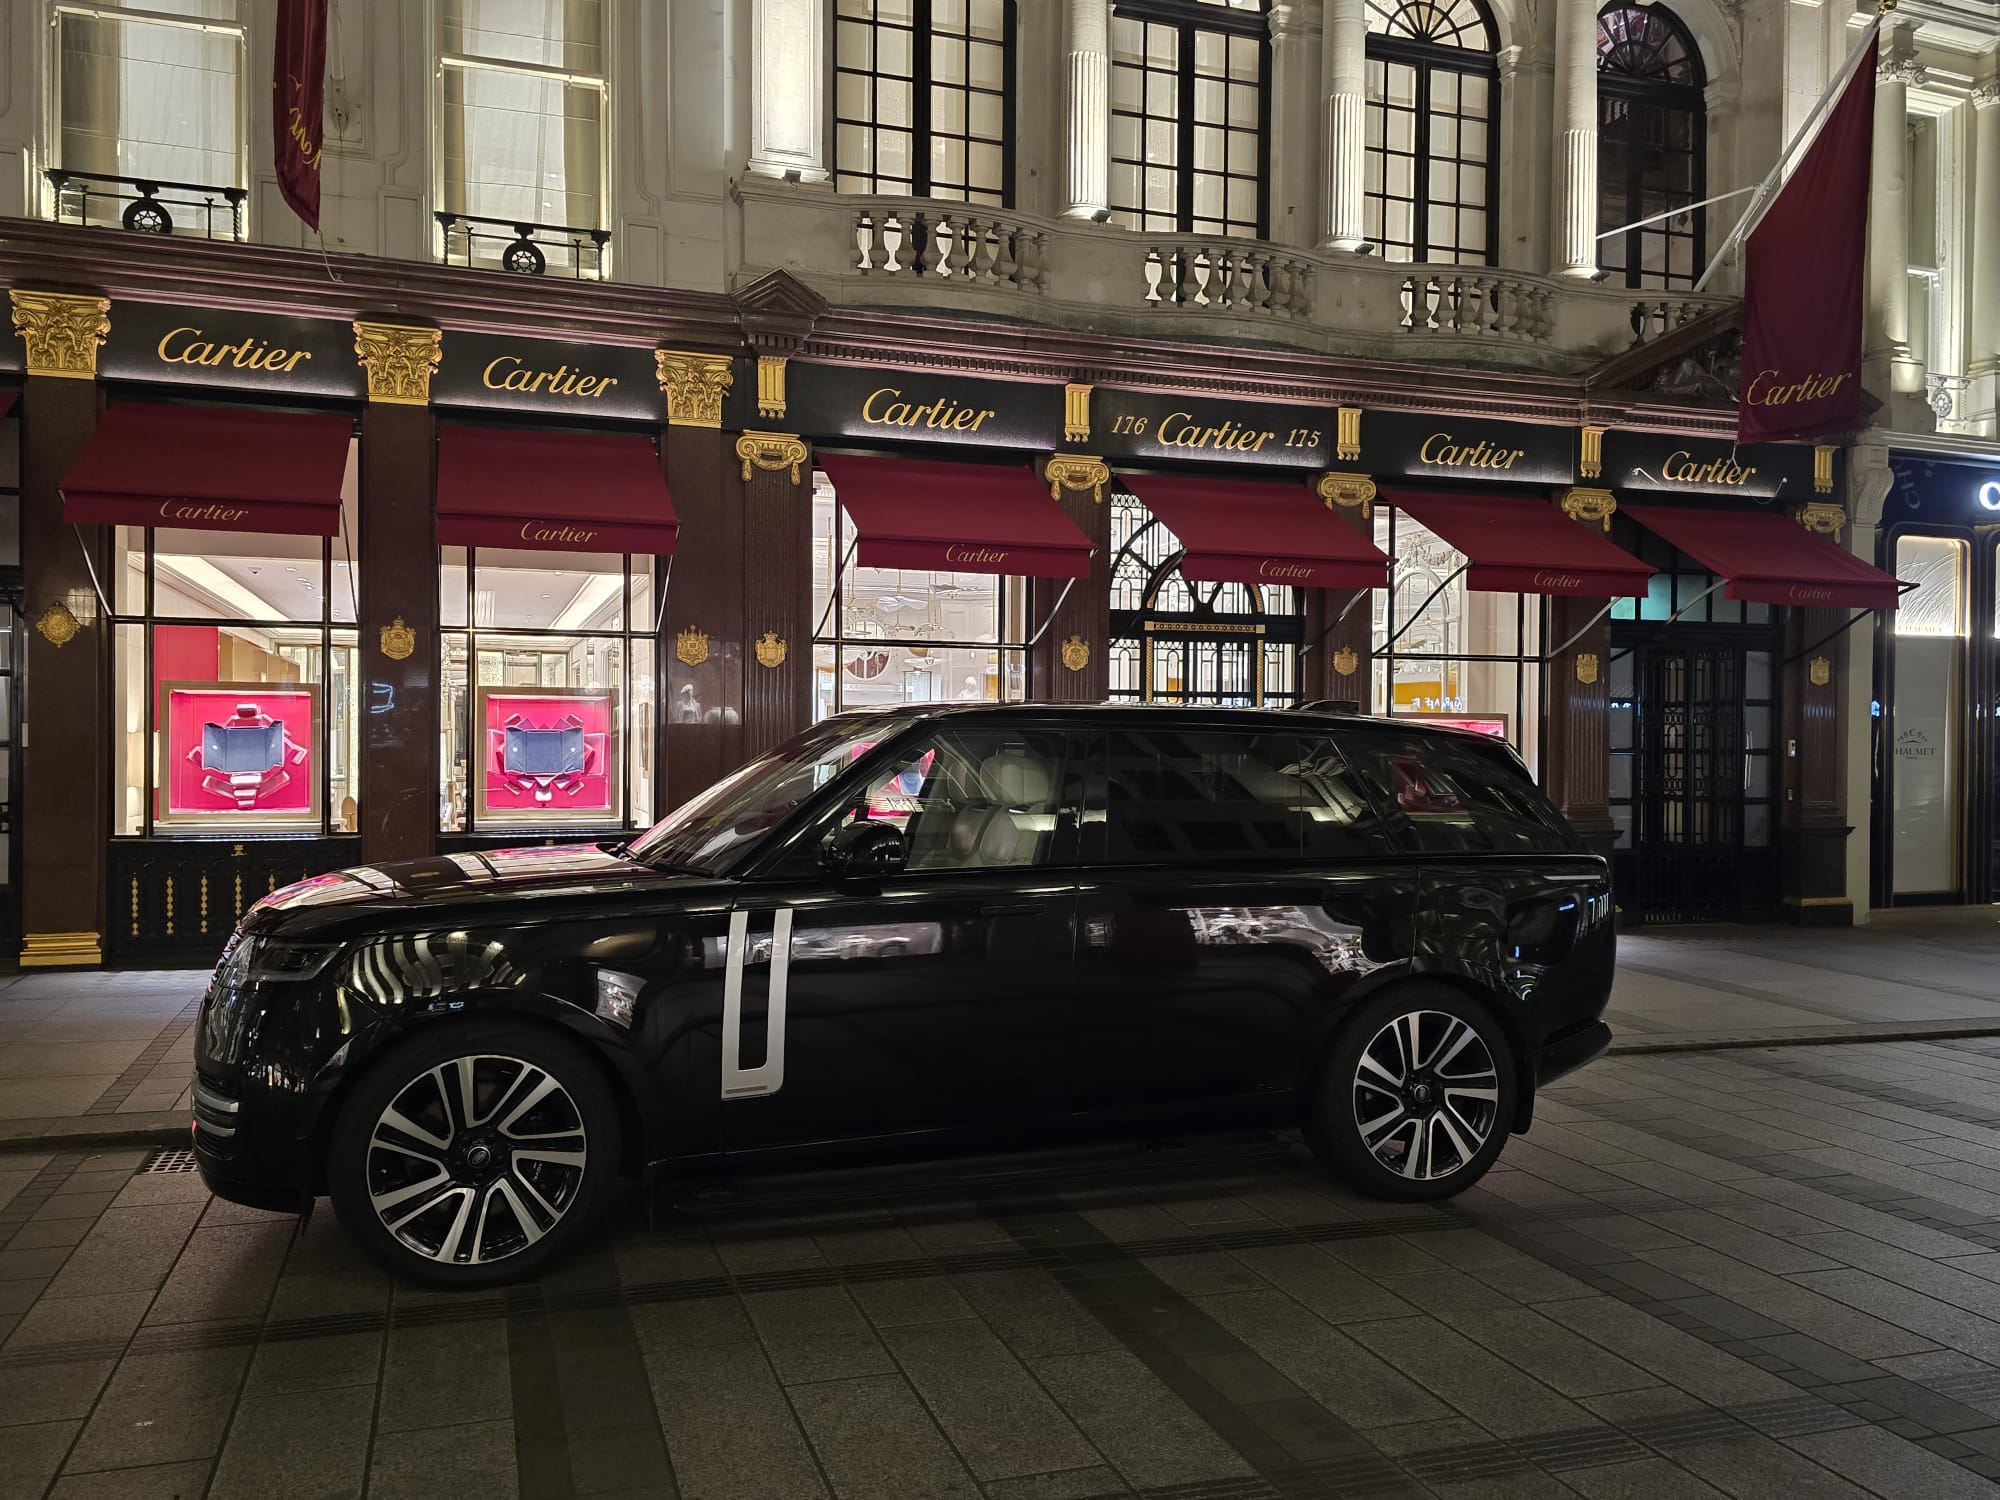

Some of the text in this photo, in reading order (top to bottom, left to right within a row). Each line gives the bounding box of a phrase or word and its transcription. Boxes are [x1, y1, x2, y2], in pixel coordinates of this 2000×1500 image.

[157, 326, 312, 373] Cartier
[482, 356, 618, 397] Cartier
[1746, 369, 1853, 409] Cartier
[861, 387, 995, 432] Cartier
[1110, 411, 1321, 452] 176 Cartier 175
[1419, 432, 1525, 470] Cartier
[1661, 450, 1757, 486] Cartier
[159, 496, 249, 523] Cartier
[520, 520, 598, 545] Cartier
[945, 543, 1009, 565] Cartier
[1259, 558, 1316, 579] Cartier
[1532, 569, 1583, 590] Cartier
[1789, 584, 1836, 602] Cartier
[1895, 747, 1937, 756] HAUMET
